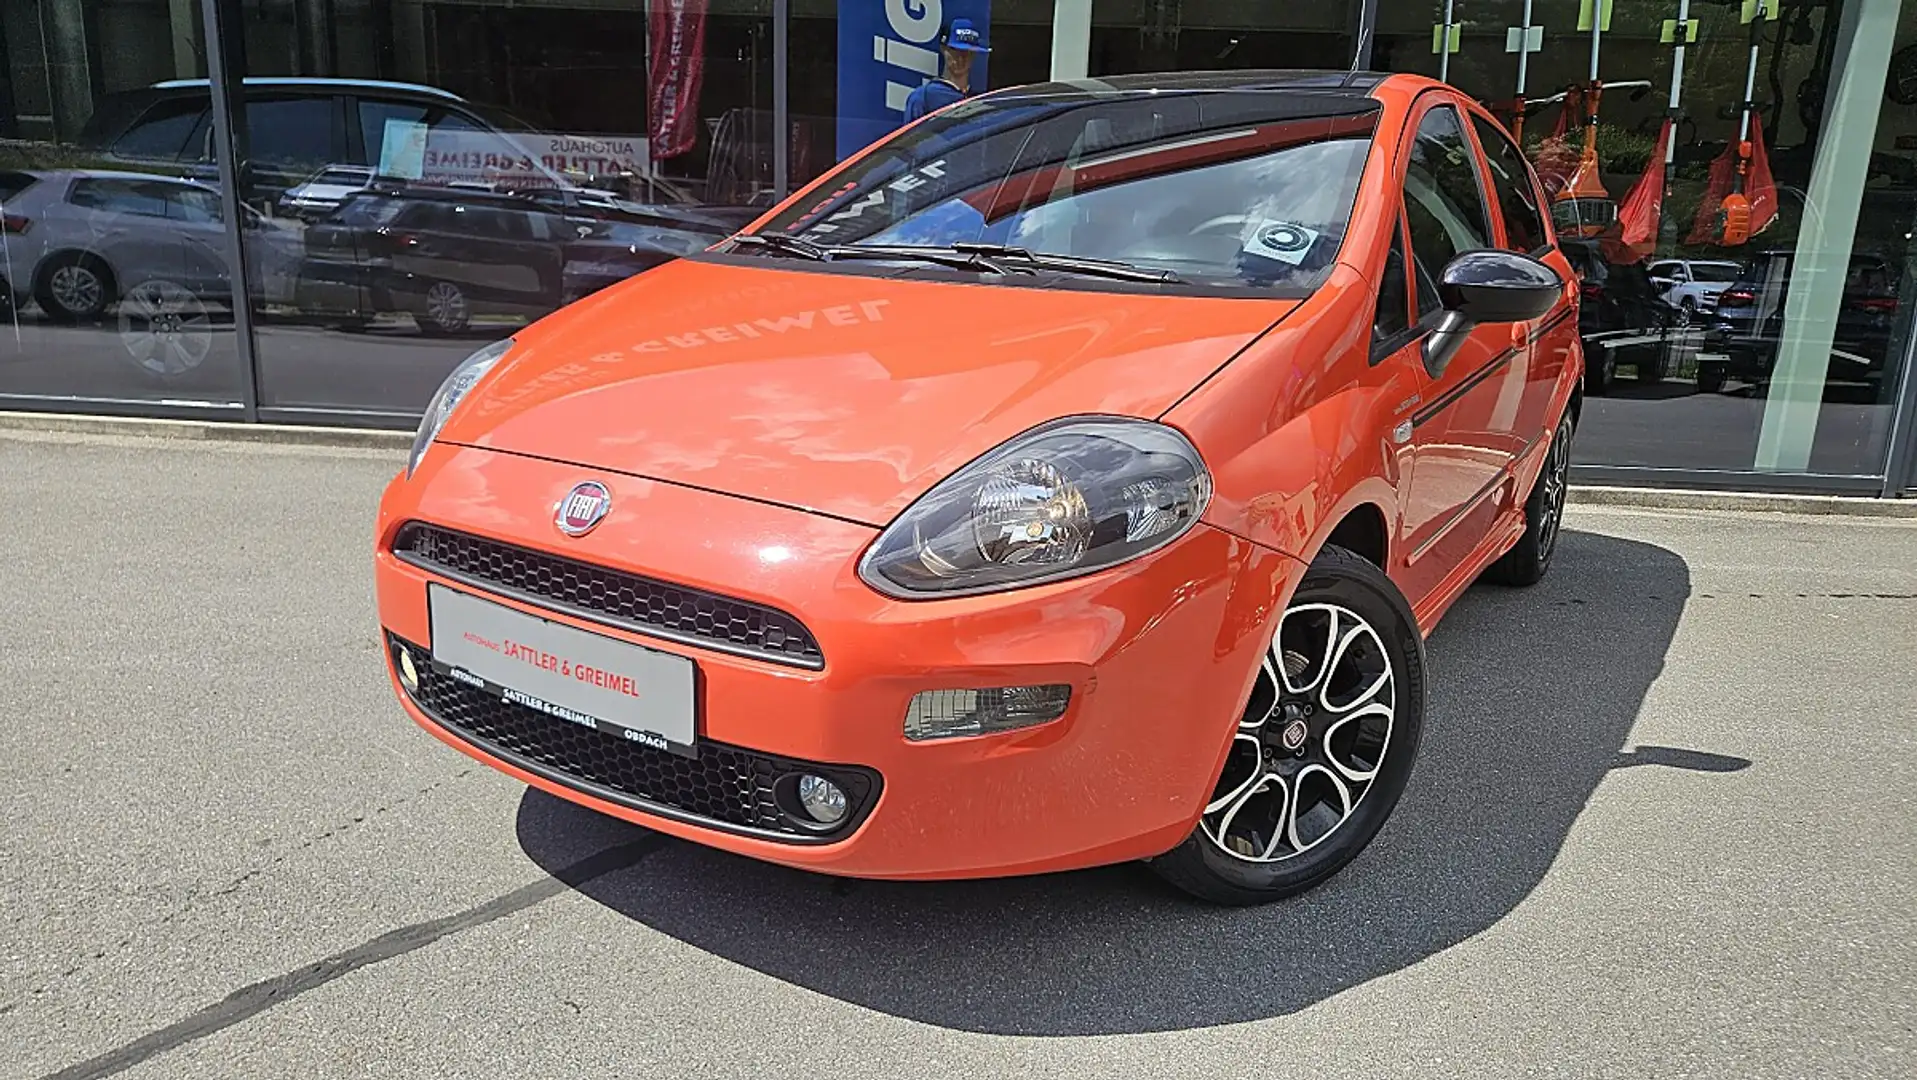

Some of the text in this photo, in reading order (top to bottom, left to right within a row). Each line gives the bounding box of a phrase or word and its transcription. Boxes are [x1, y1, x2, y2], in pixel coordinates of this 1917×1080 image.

[671, 0, 685, 67] GREIME
[567, 494, 602, 521] FIAT
[463, 631, 640, 698] AUTOHAUS SATTLER & GREIMEL
[450, 668, 668, 751] AUTOHAUS SATTLER & GREIMEL OBDACH
